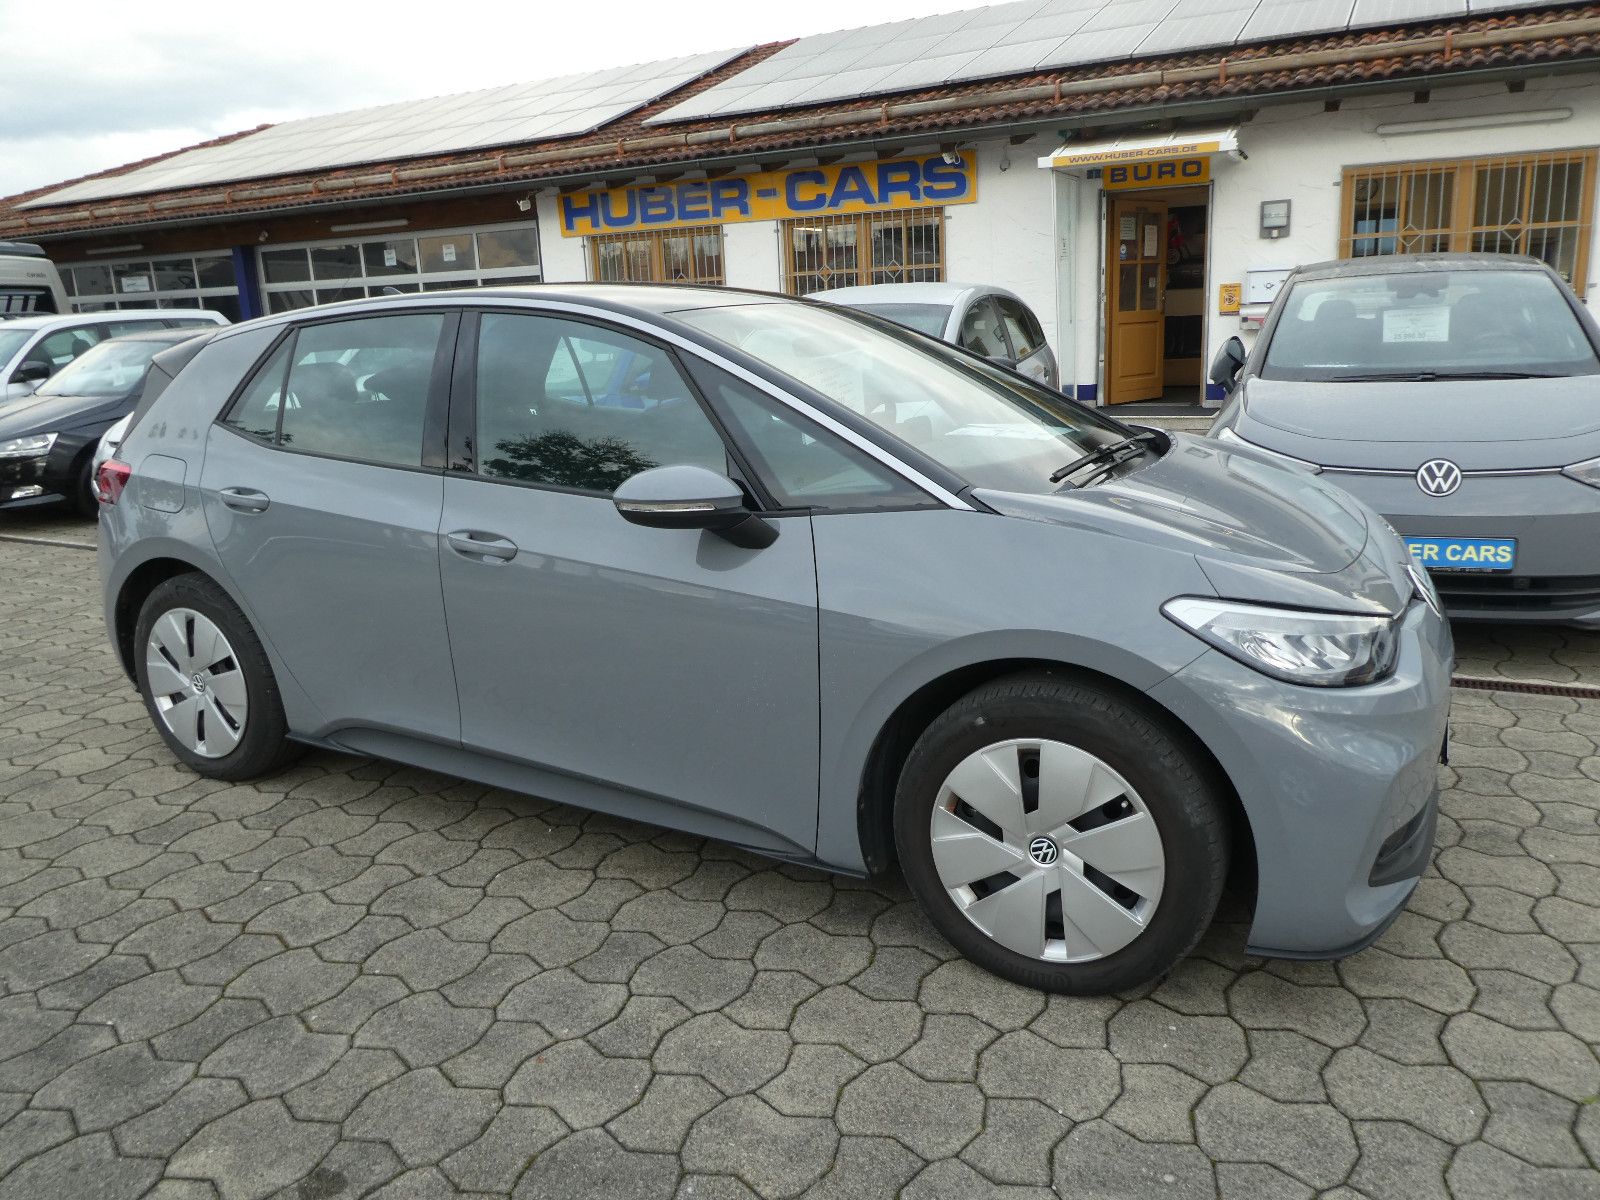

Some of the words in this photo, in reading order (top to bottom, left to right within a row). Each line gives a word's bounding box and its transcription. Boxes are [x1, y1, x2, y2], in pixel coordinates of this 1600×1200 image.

[1069, 145, 1197, 164] WWW.HUBER-CARS.DE
[564, 158, 967, 231] HUBER-CARS
[1445, 544, 1512, 563] CARS
